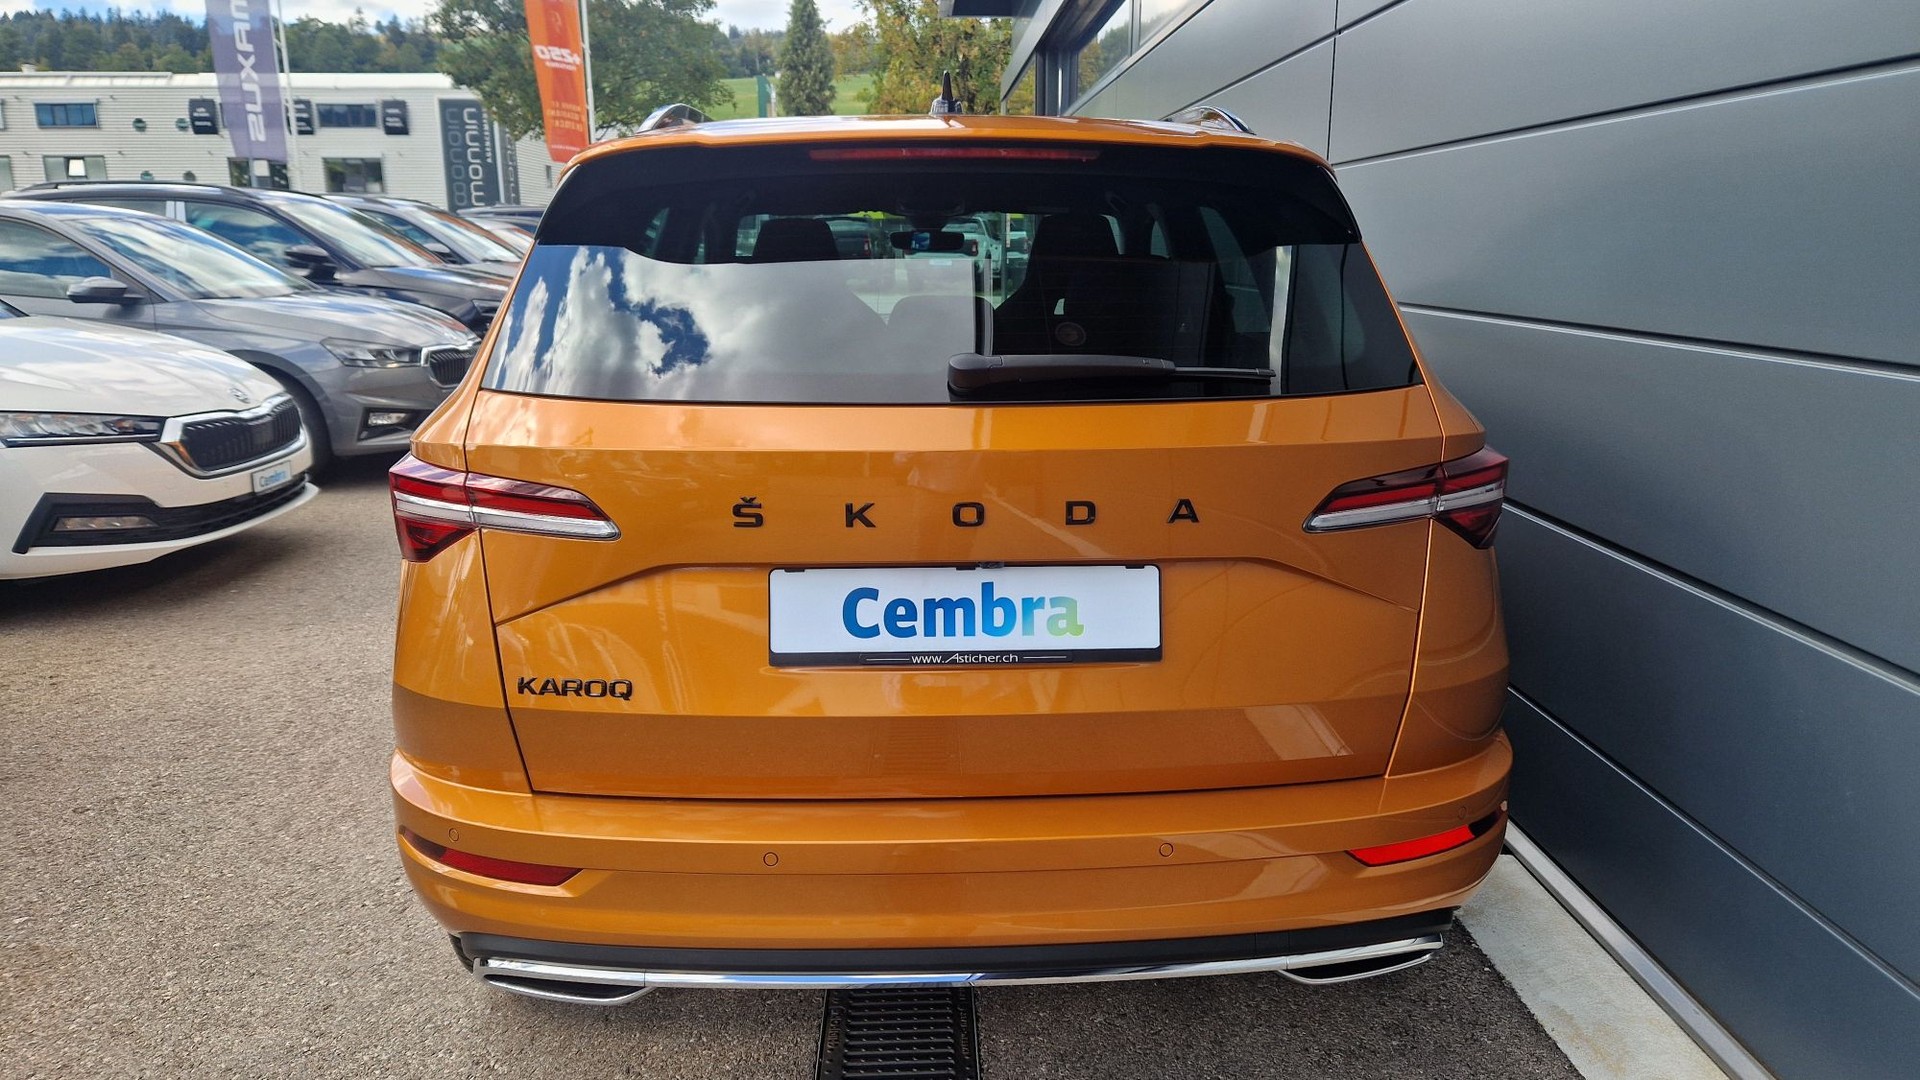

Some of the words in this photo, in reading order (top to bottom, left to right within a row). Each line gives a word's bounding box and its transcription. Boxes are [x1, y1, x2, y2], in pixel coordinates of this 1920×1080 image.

[463, 107, 486, 206] monnin
[732, 496, 1200, 528] ŠKODA
[842, 581, 1085, 639] Cembra
[911, 652, 1019, 664] www.Asticher.ch
[517, 677, 633, 700] KAROQ
